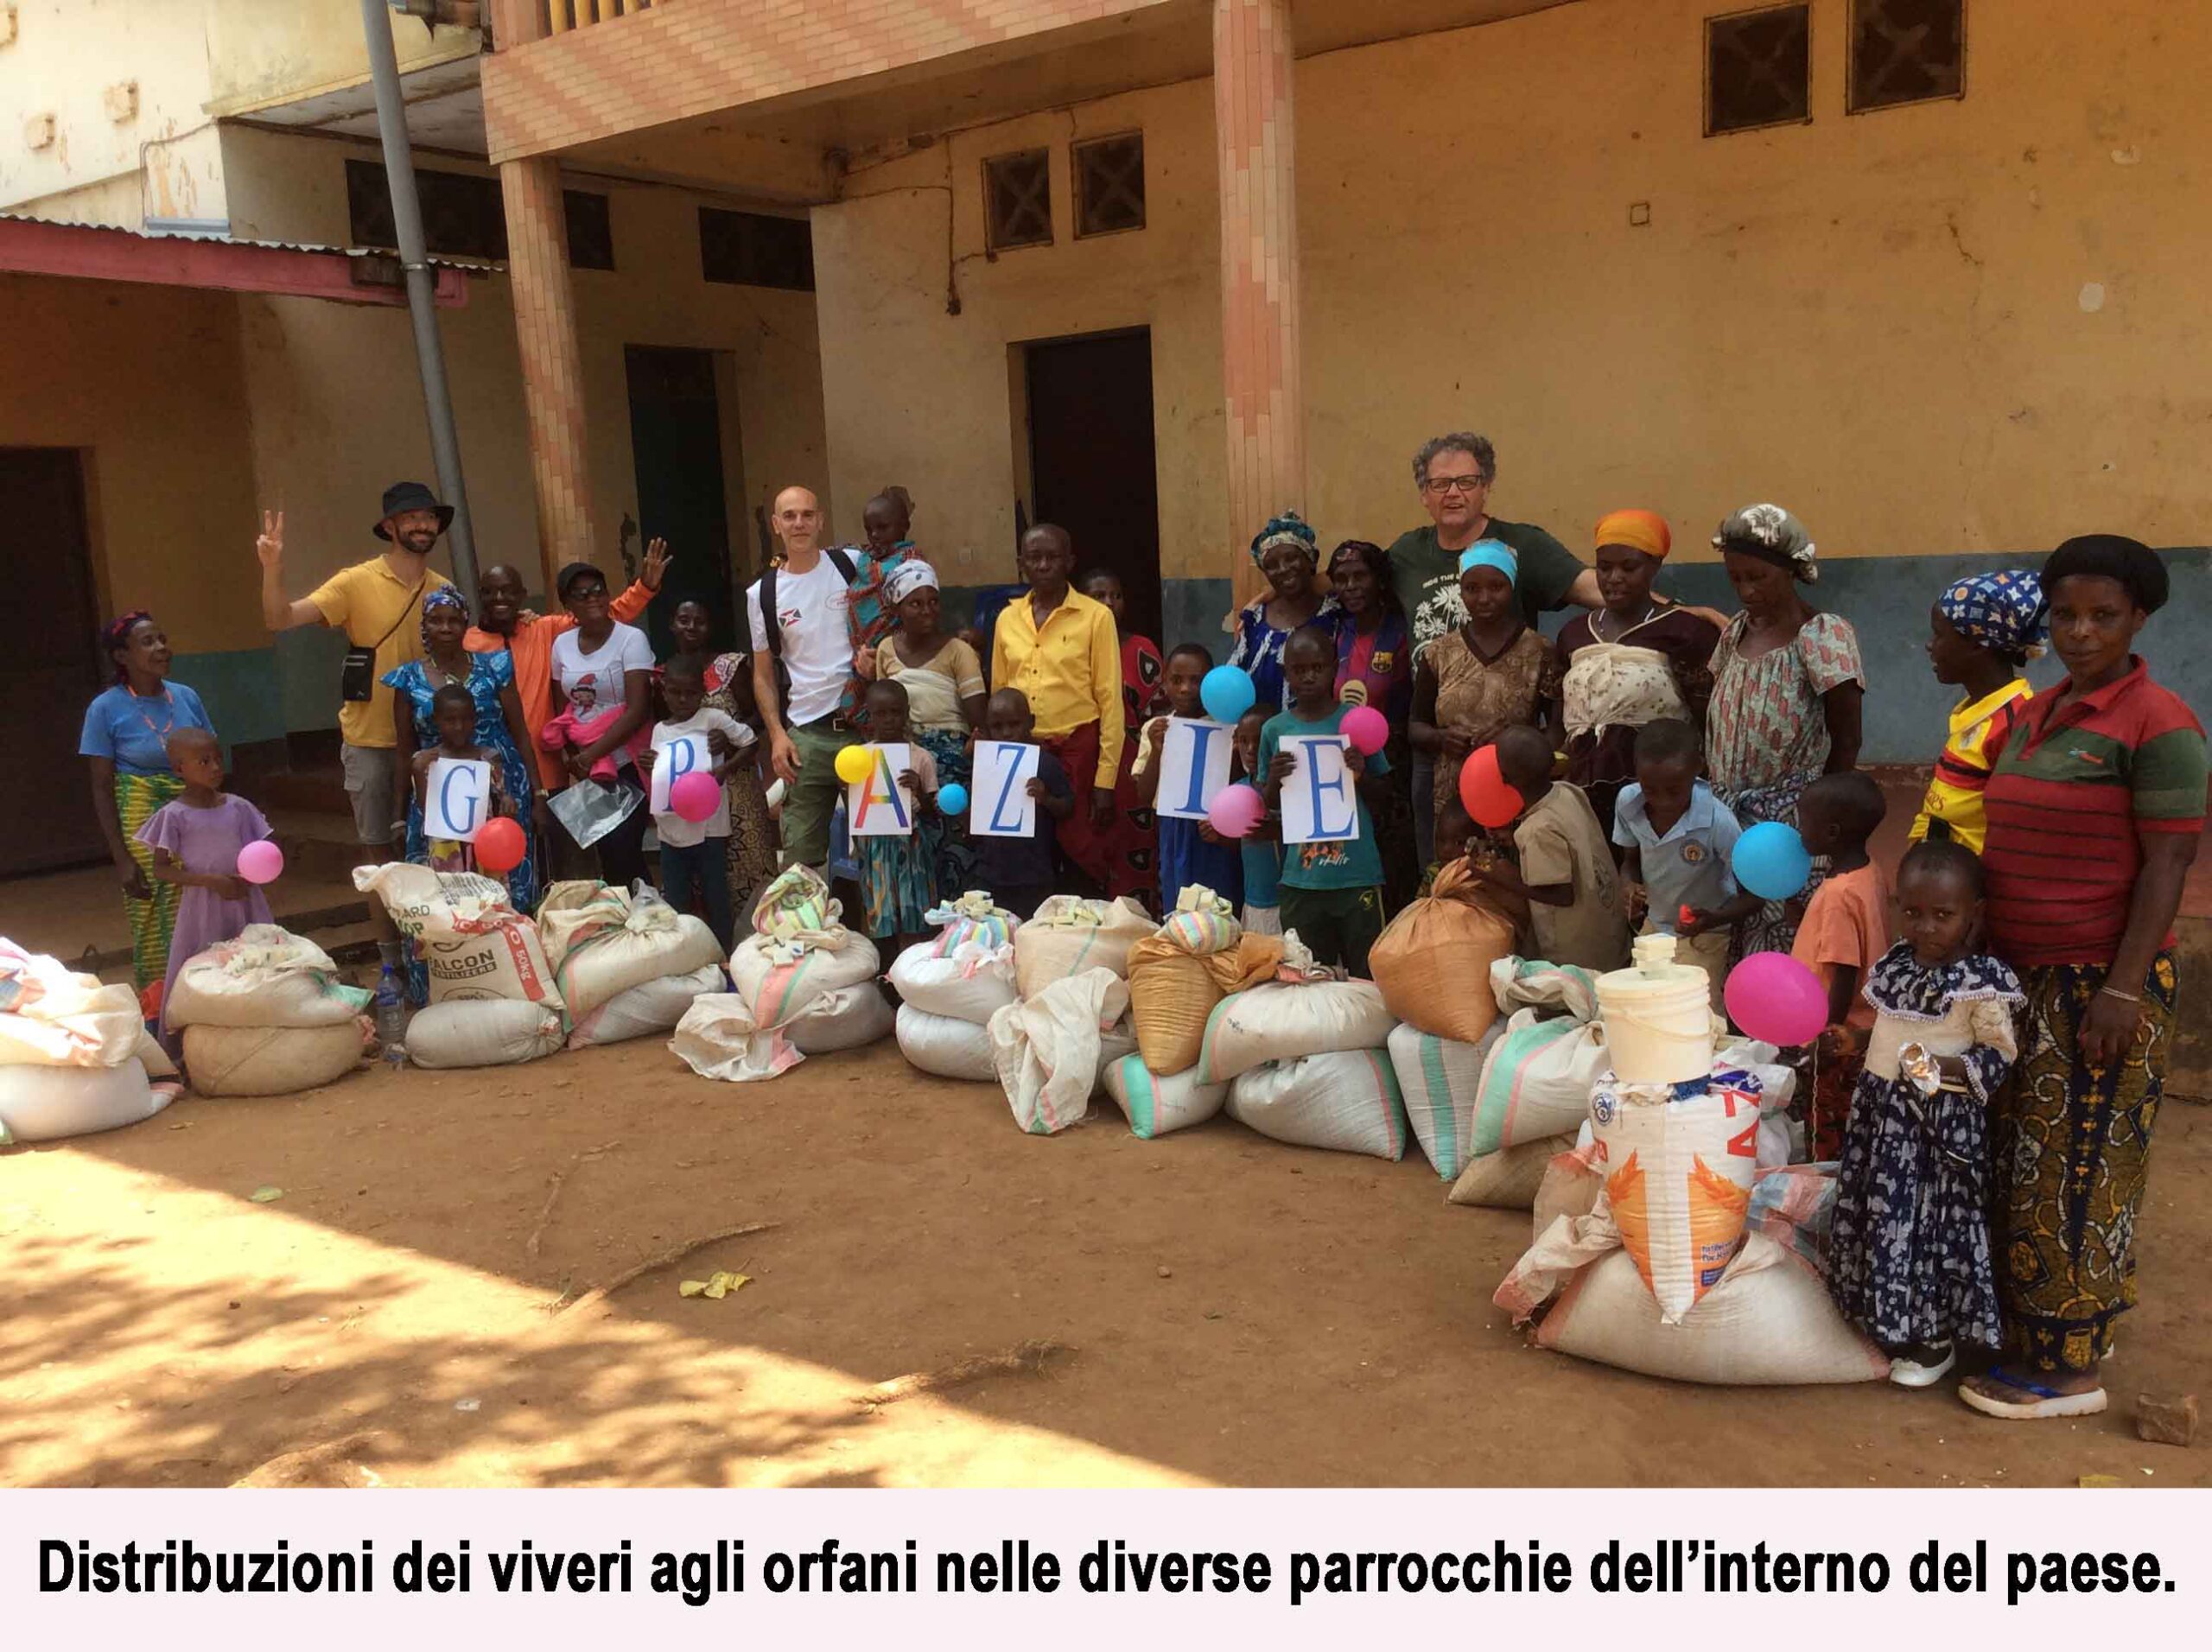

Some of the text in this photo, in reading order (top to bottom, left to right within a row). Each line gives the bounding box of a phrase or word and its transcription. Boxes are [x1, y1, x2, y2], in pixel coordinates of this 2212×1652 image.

[441, 765, 480, 835] G
[854, 747, 909, 829] A
[989, 744, 1027, 832] Z
[1174, 723, 1223, 815] I
[1299, 739, 1355, 839] E
[429, 949, 494, 971] ALCON
